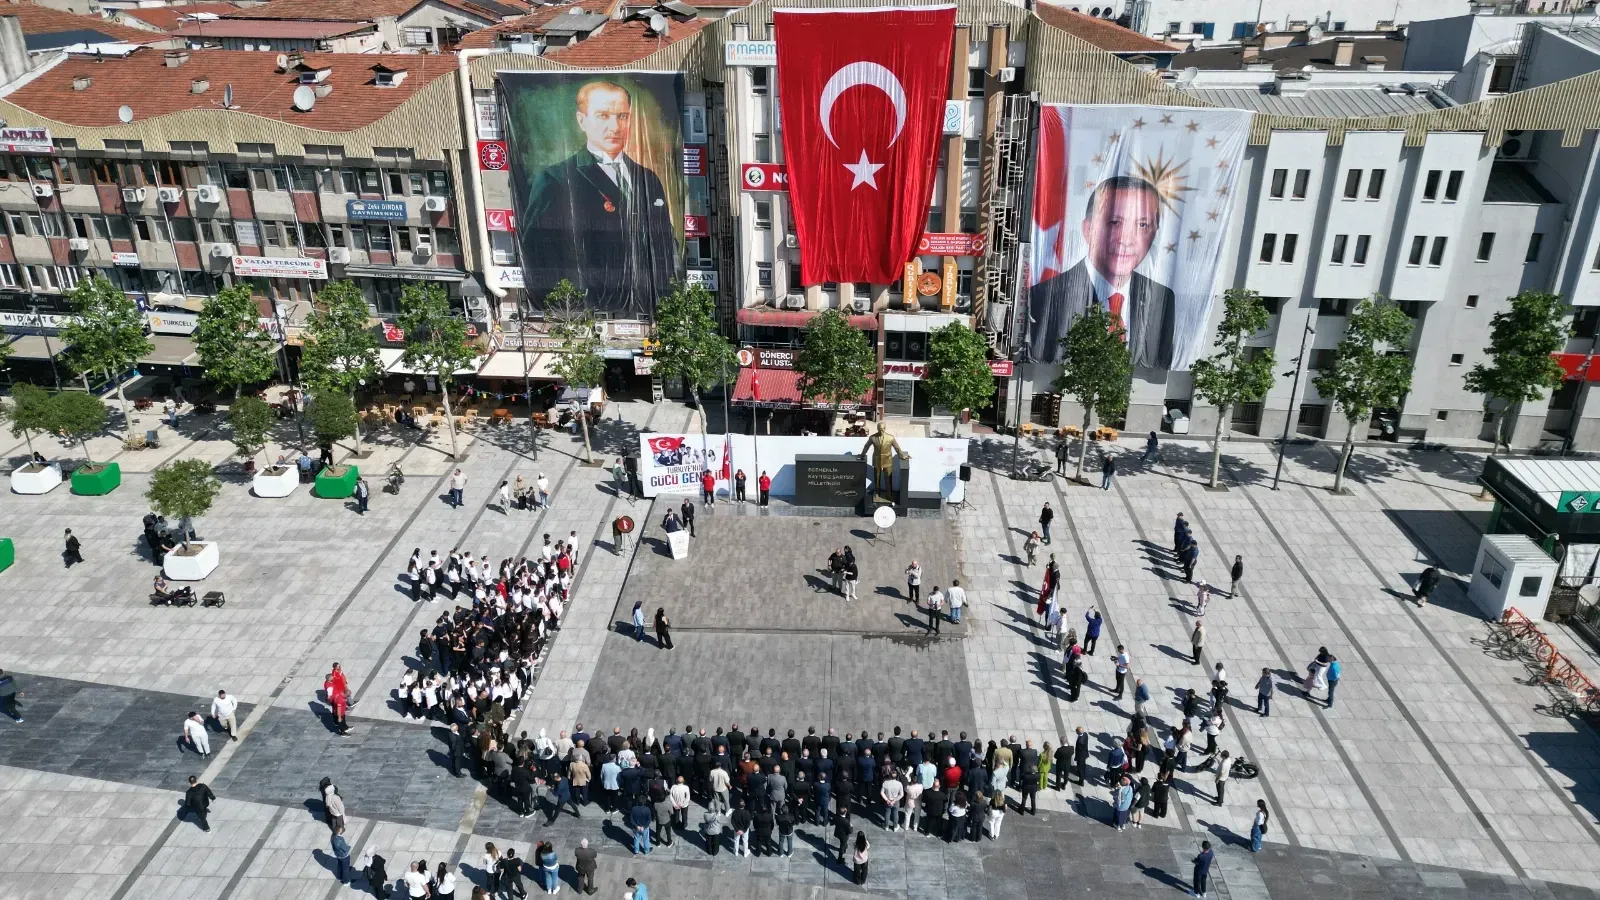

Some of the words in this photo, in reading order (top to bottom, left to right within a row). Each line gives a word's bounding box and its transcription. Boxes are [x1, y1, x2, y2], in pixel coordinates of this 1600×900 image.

[906, 264, 915, 304] QUALITY
[946, 265, 954, 304] TRAVEL
[4, 314, 54, 324] MIDATE
[760, 351, 793, 360] DÖNERCİ
[667, 464, 703, 474] TÜRKİYE'NİN
[650, 473, 679, 487] GÜCÜ
